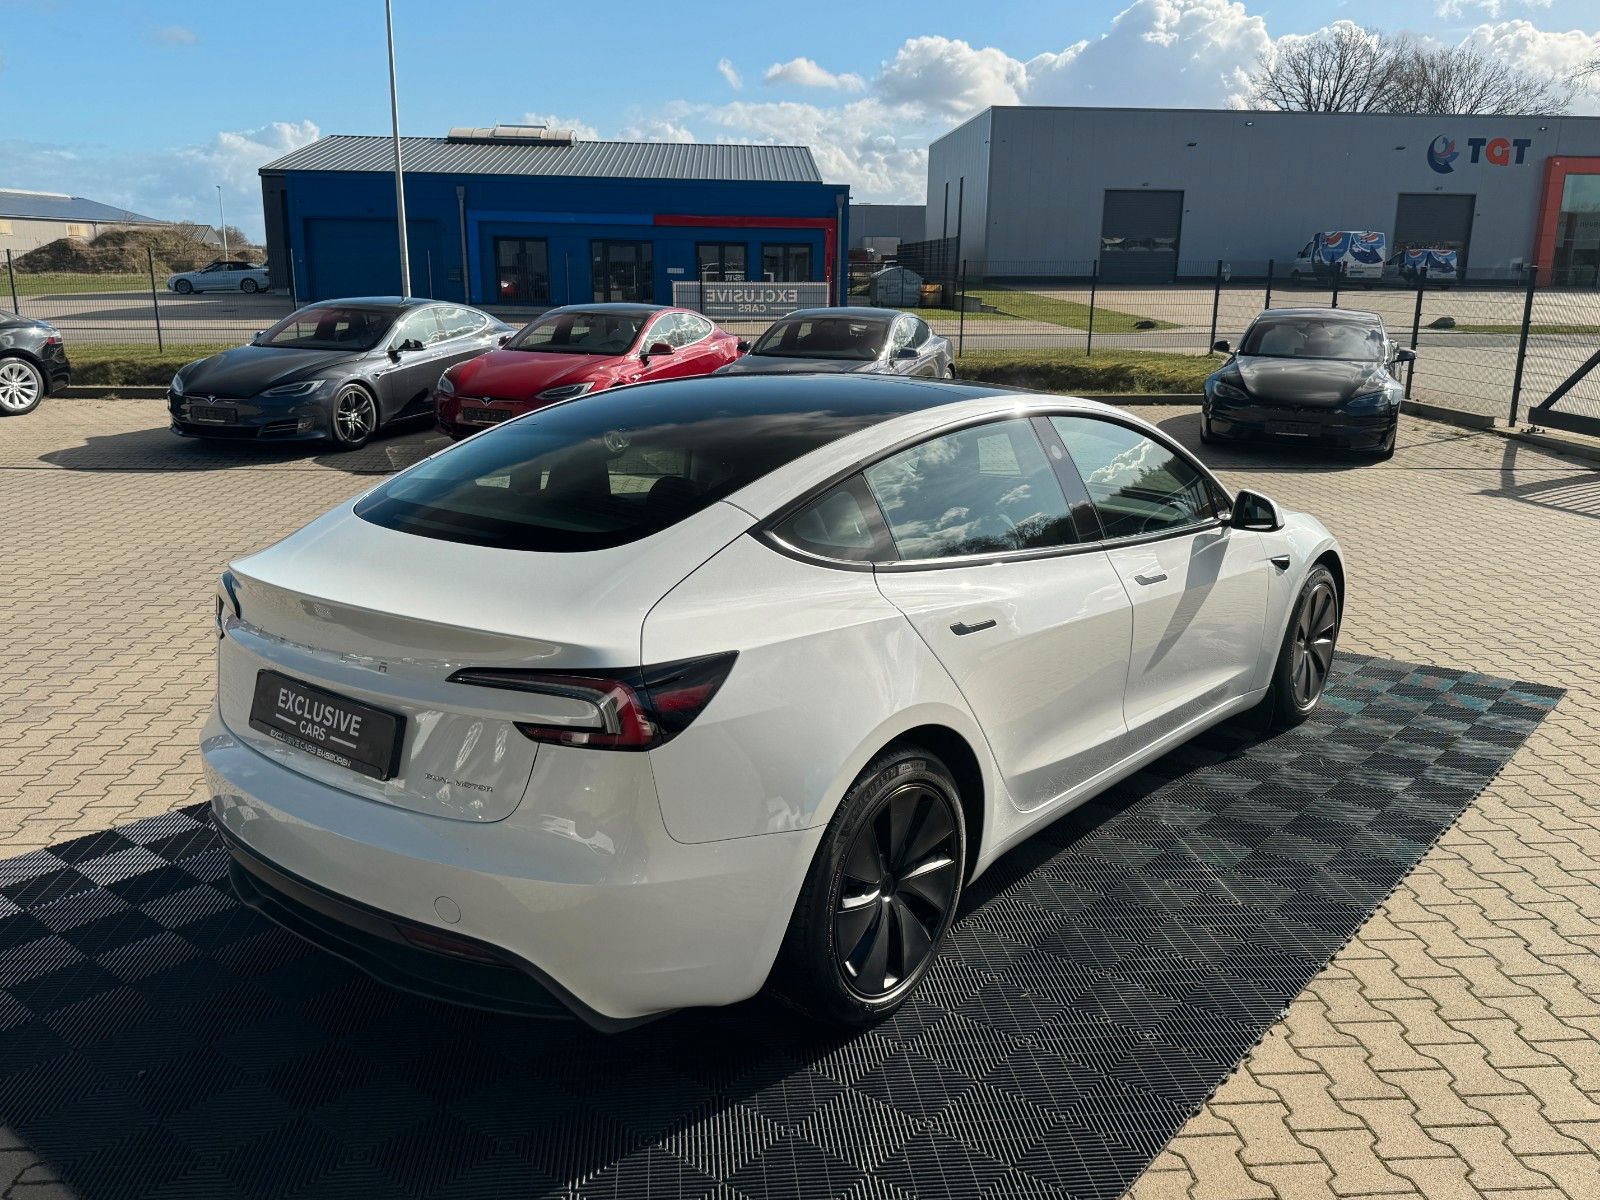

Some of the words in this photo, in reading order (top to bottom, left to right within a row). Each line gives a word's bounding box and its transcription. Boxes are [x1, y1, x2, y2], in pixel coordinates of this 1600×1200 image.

[1467, 137, 1531, 166] TGT
[277, 687, 362, 737] EXCLUSIVE
[299, 720, 326, 741] CARS
[300, 741, 317, 754] CARS
[455, 780, 494, 793] MOTOR
